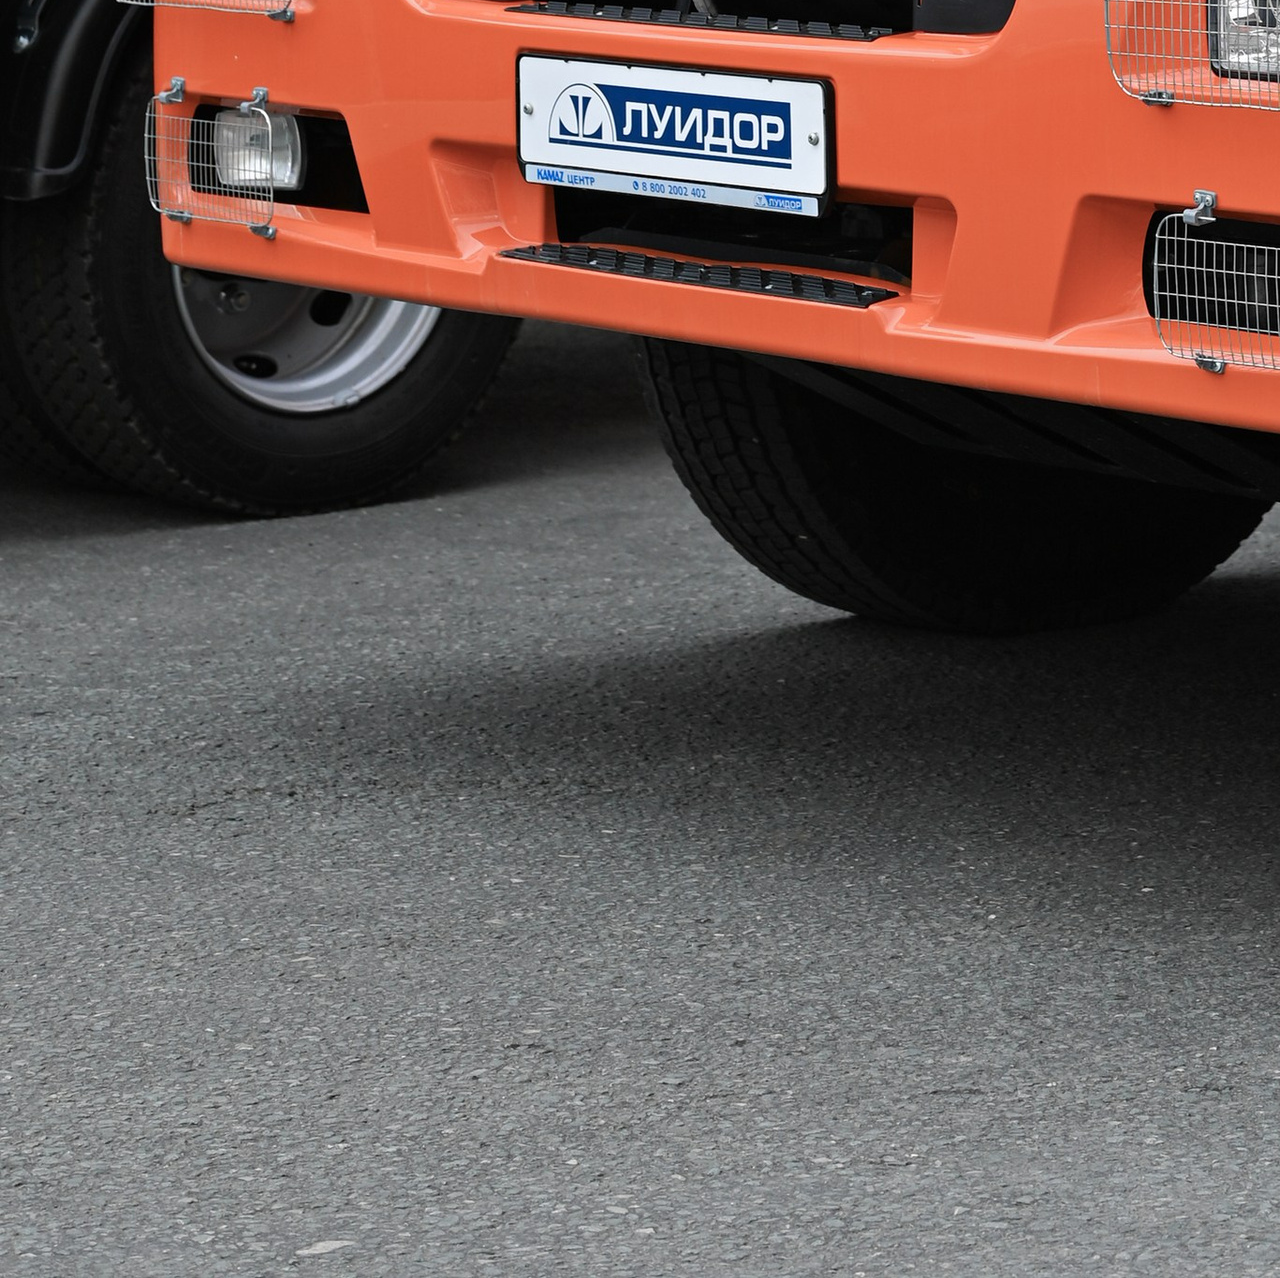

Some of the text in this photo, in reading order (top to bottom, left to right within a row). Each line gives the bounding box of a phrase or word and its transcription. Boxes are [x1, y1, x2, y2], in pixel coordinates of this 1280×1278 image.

[622, 100, 785, 154] ЛУИДОР
[536, 168, 565, 183] KAMAZ
[567, 174, 596, 187] ЦЕНТР
[641, 181, 706, 199] 8 800 2002 402
[767, 197, 802, 210] ЛУИДОР
